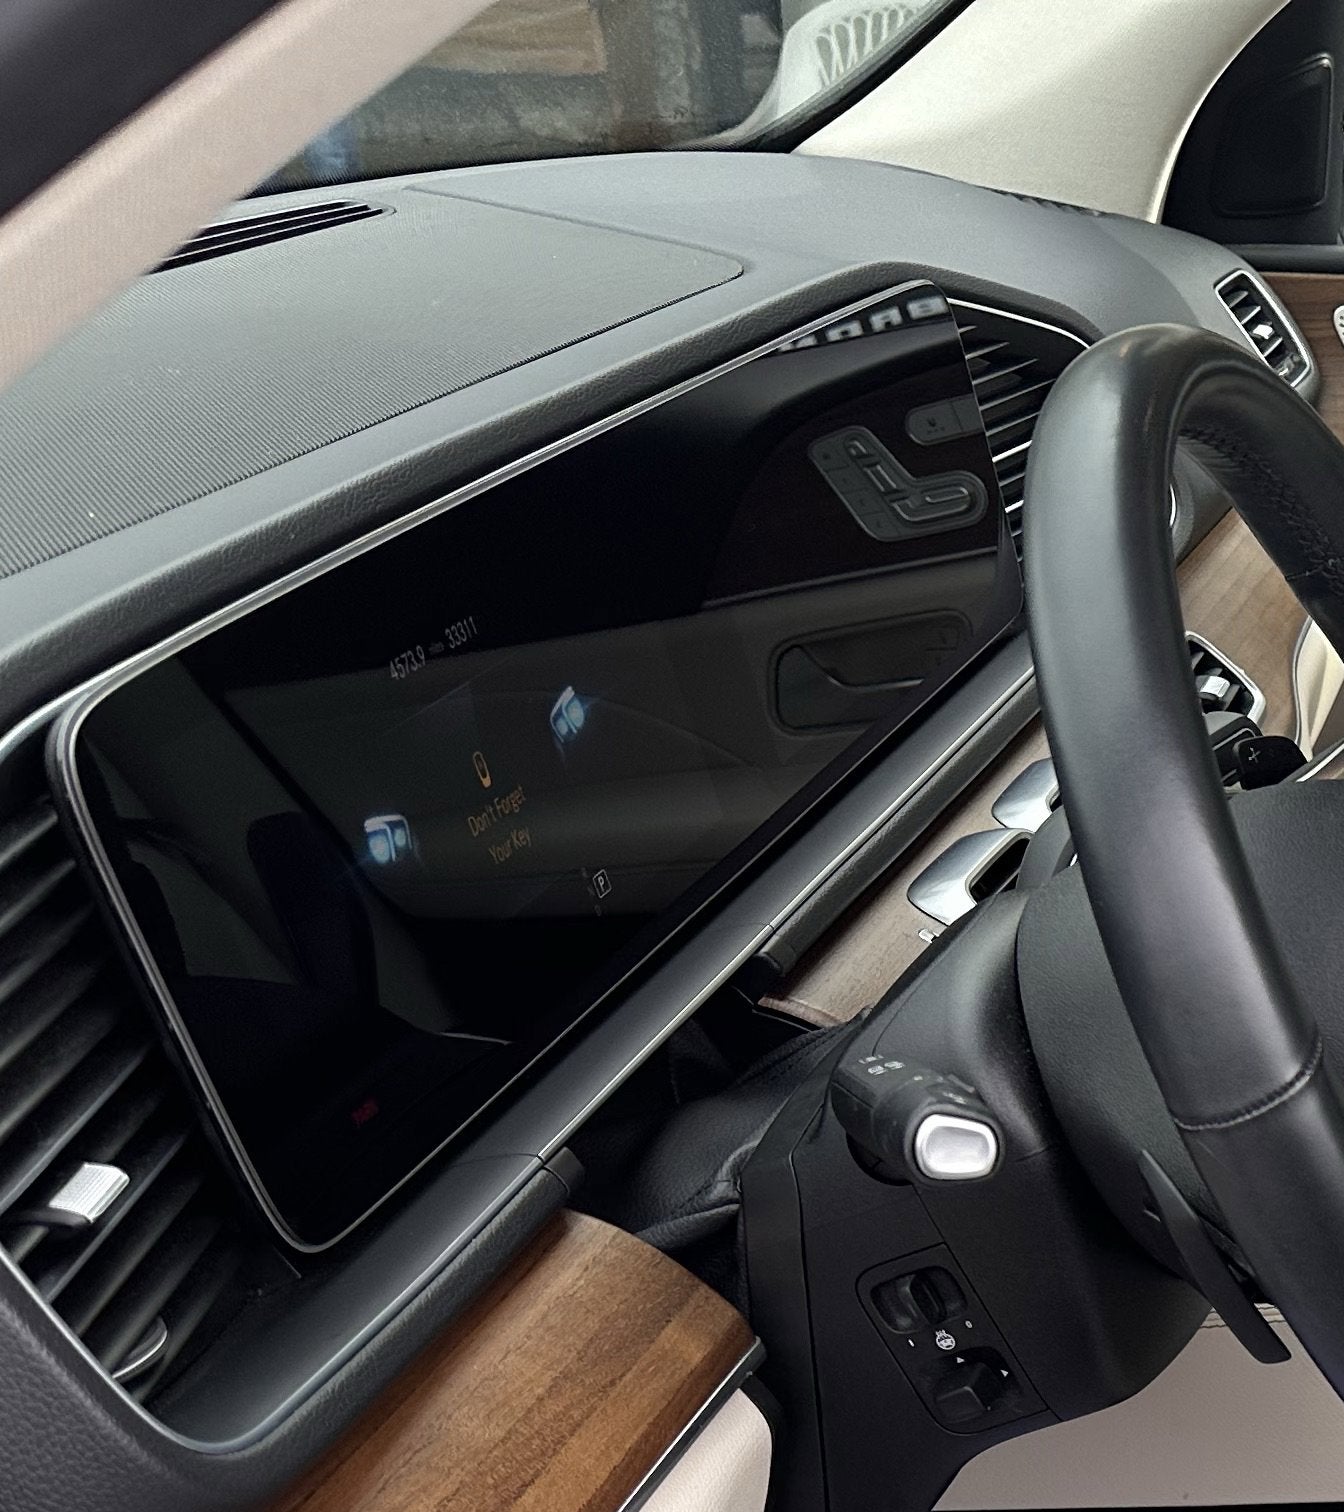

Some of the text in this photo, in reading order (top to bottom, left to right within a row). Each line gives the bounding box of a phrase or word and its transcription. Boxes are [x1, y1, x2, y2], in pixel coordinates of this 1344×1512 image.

[468, 786, 527, 837] Don't Forget
[510, 827, 532, 850] Key
